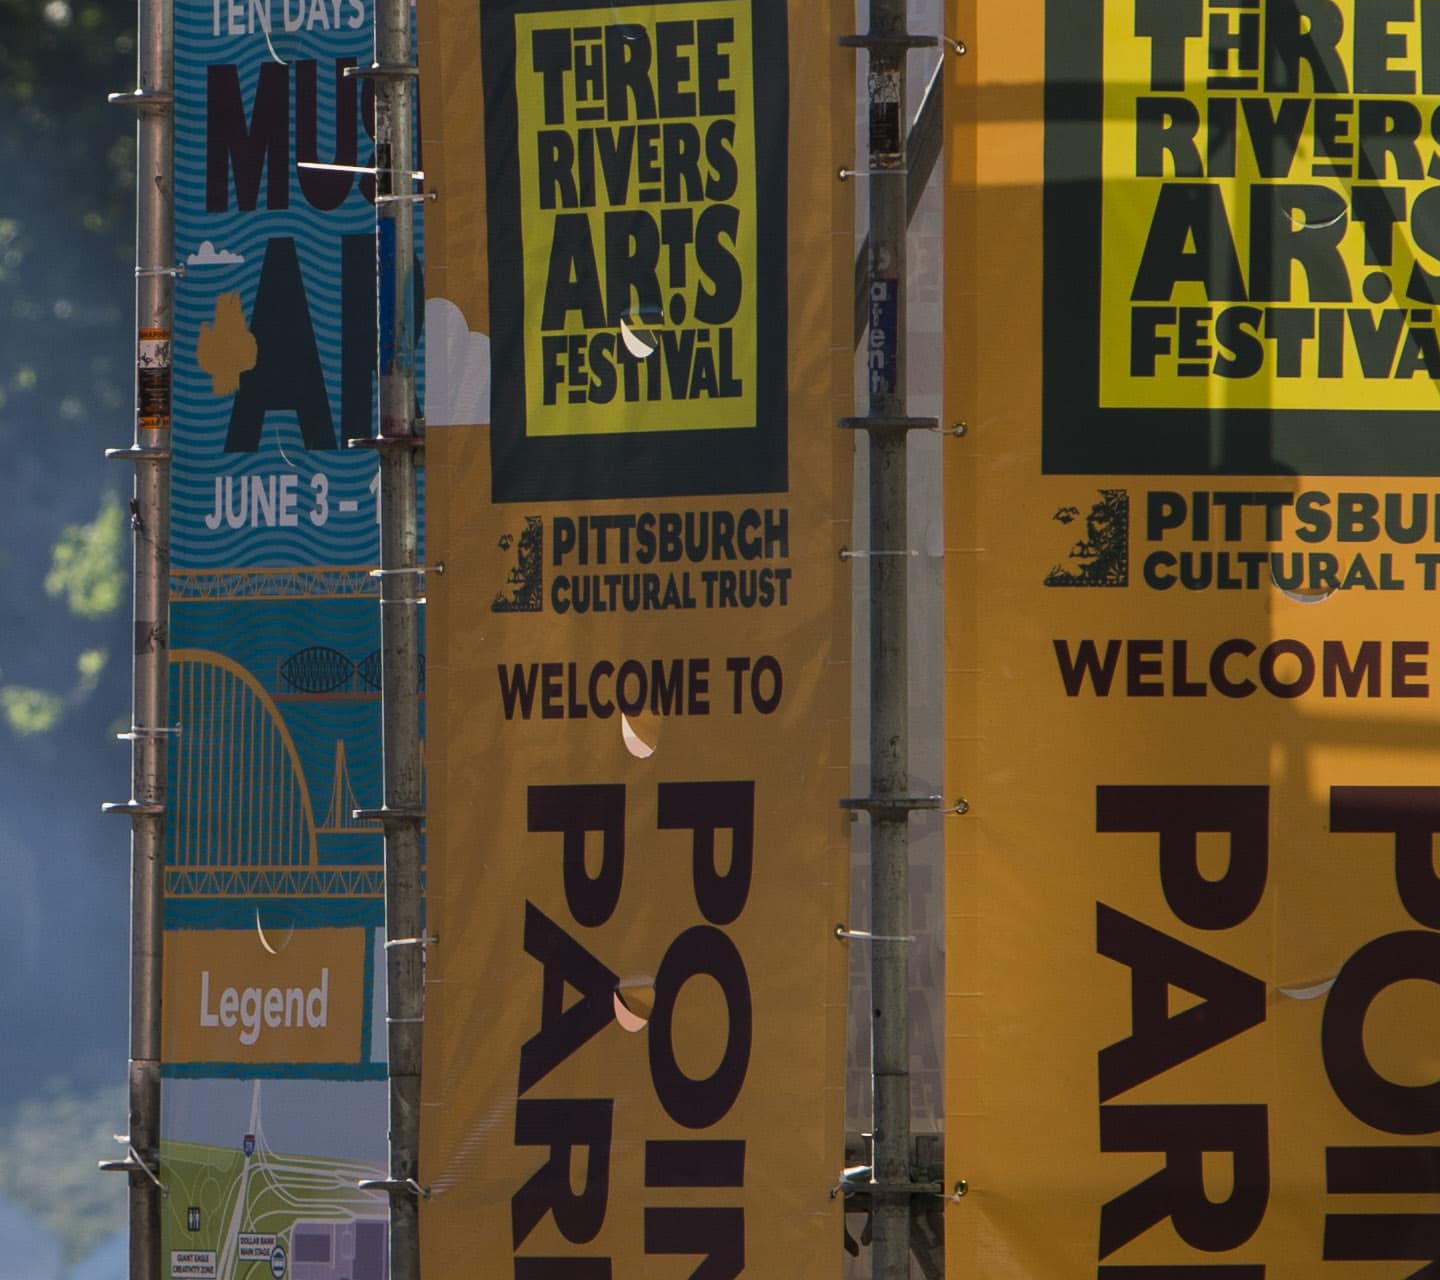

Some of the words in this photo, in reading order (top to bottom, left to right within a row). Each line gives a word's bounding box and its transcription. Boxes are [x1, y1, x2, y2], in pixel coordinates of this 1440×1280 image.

[531, 18, 736, 126] THREE
[538, 120, 739, 209] RIVERS
[541, 204, 743, 332] ARTS
[542, 324, 743, 407] FESTIVAL
[205, 474, 299, 530] JUNE
[308, 472, 329, 526] 3
[552, 507, 790, 566] PITTSBURGH
[551, 570, 696, 613] CULTURAL
[700, 568, 792, 608] TRUST
[1144, 551, 1405, 592] CULTURAL
[498, 657, 711, 721] WELCOME
[726, 656, 783, 715] TO
[1053, 639, 1431, 698] WELCOME
[199, 967, 329, 1046] Legend
